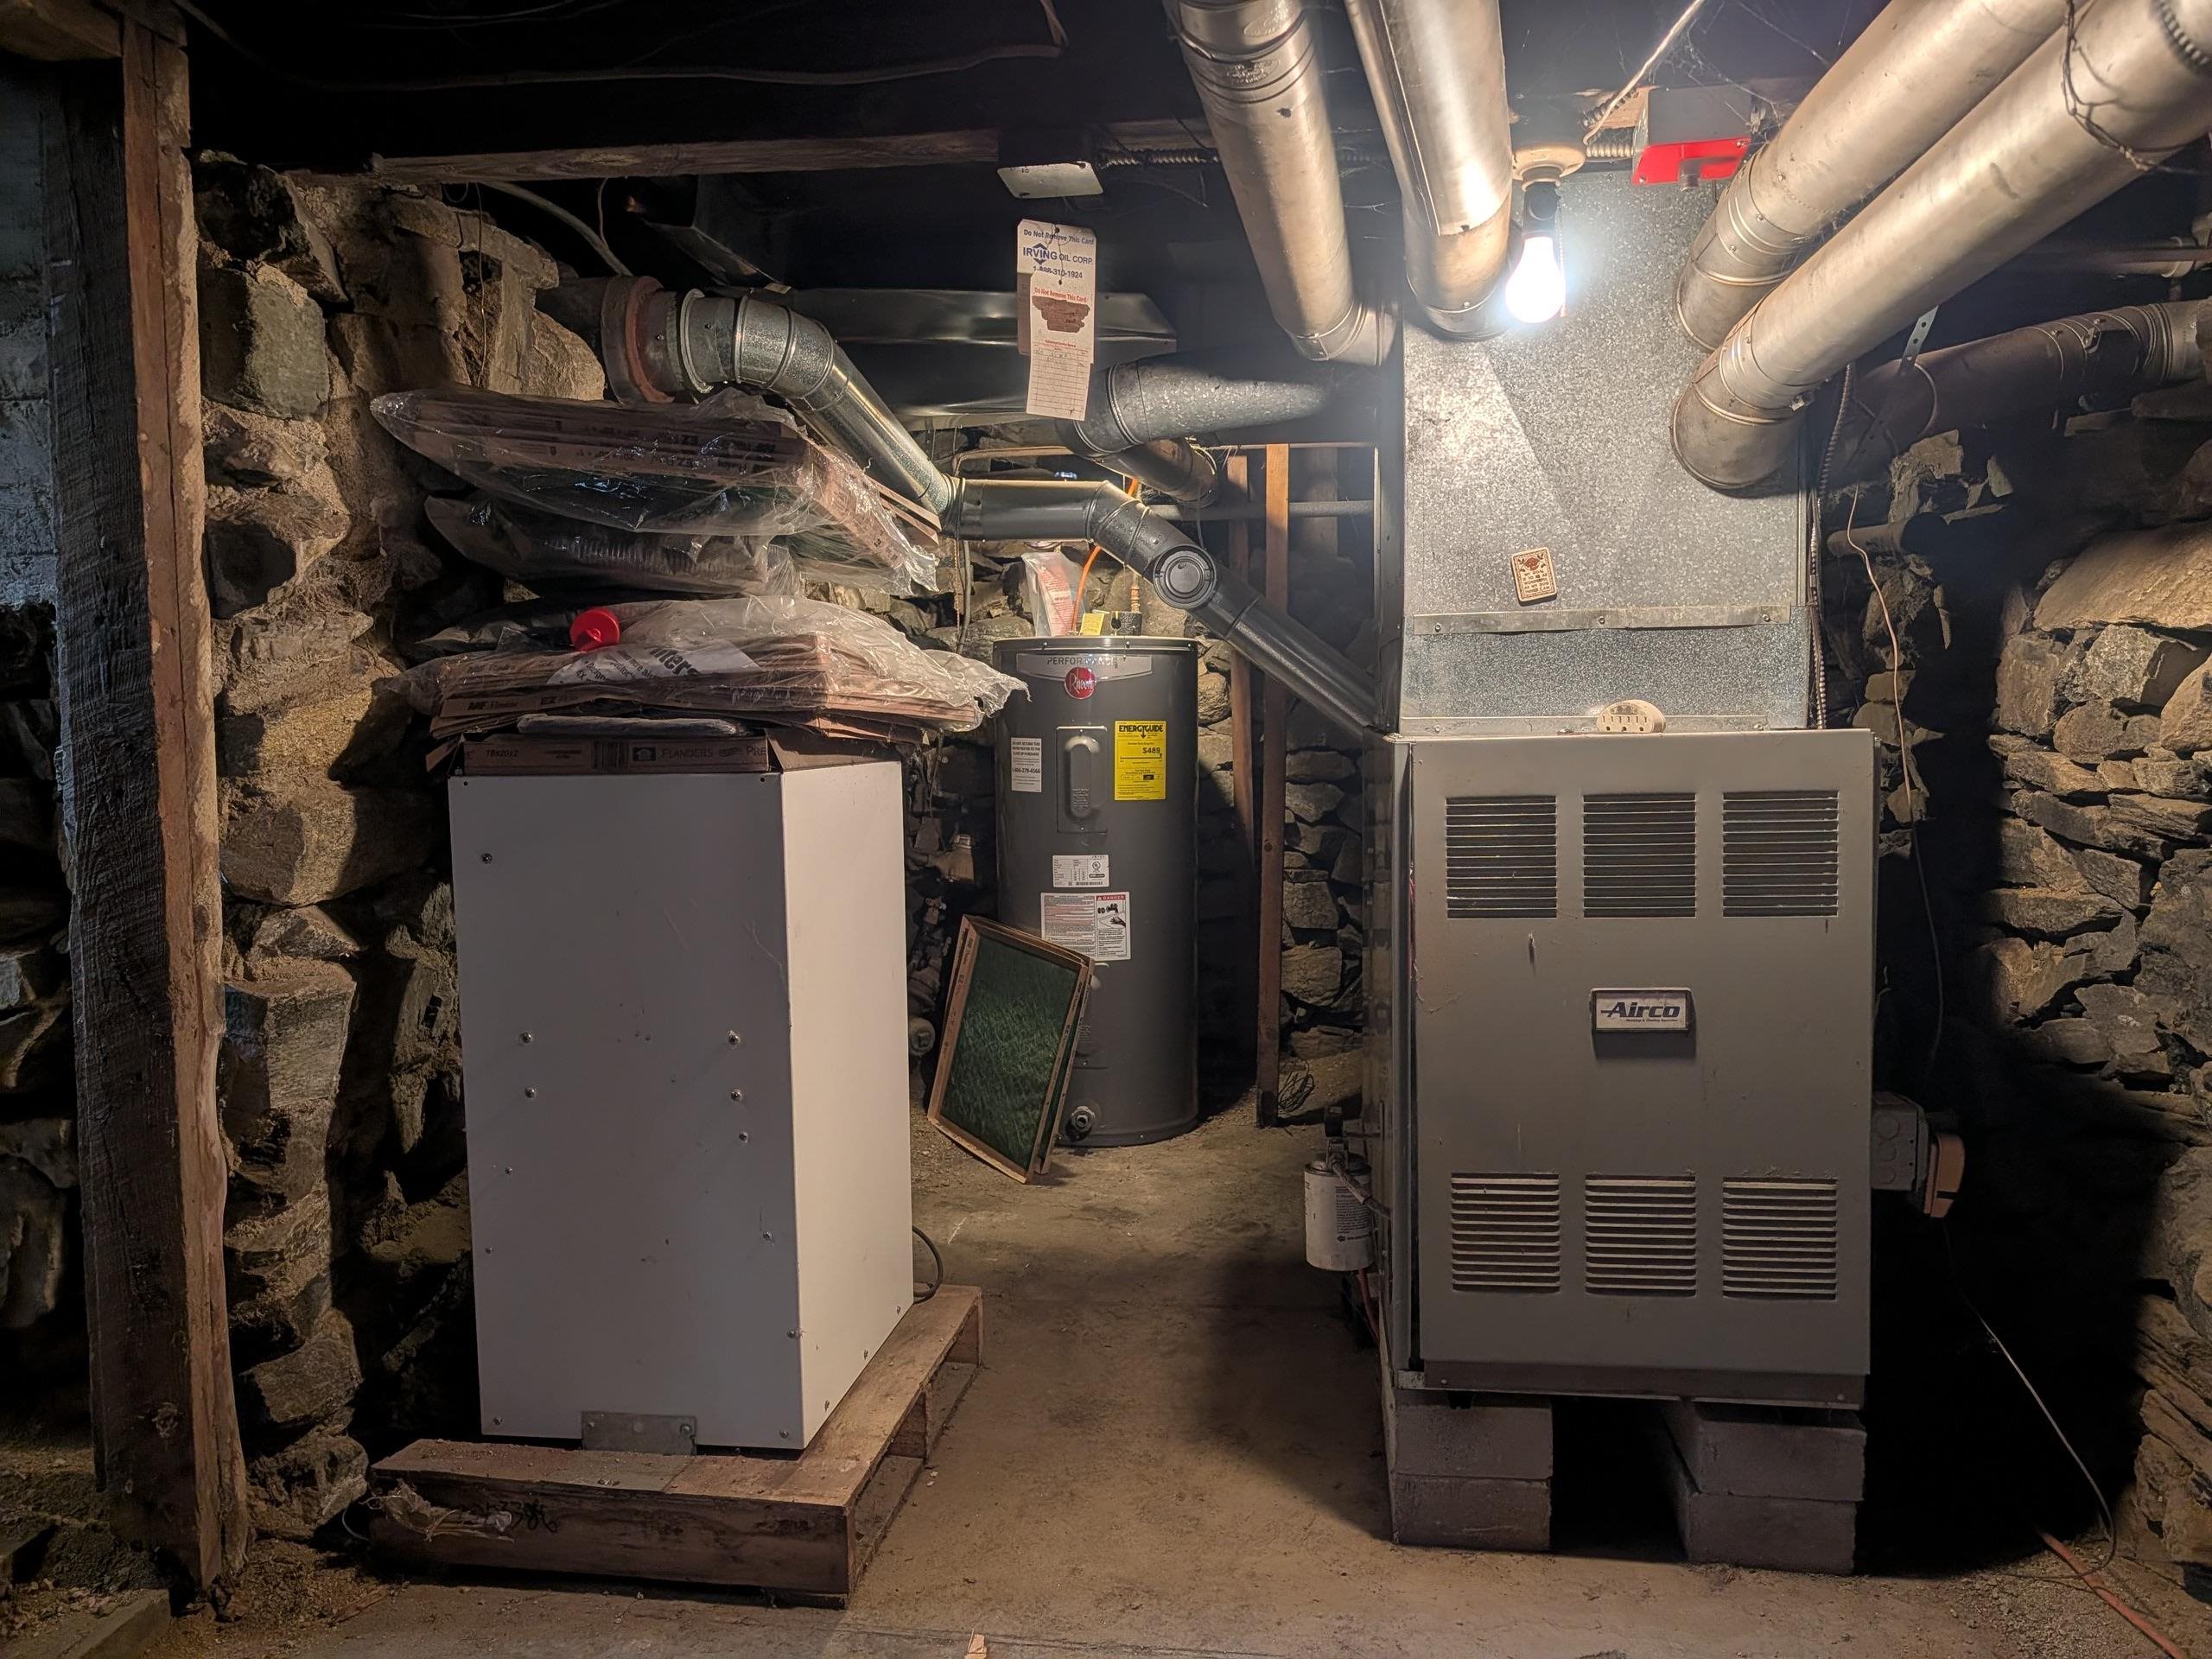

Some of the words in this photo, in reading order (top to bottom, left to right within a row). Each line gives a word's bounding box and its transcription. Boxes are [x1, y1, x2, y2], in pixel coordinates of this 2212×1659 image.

[1046, 232, 1067, 242] Remove
[1023, 246, 1057, 260] IRVING
[1058, 253, 1071, 262] OIL
[1070, 672, 1095, 694] Rheem
[661, 747, 714, 759] FLANDERS
[1601, 1001, 1681, 1018] Airco
